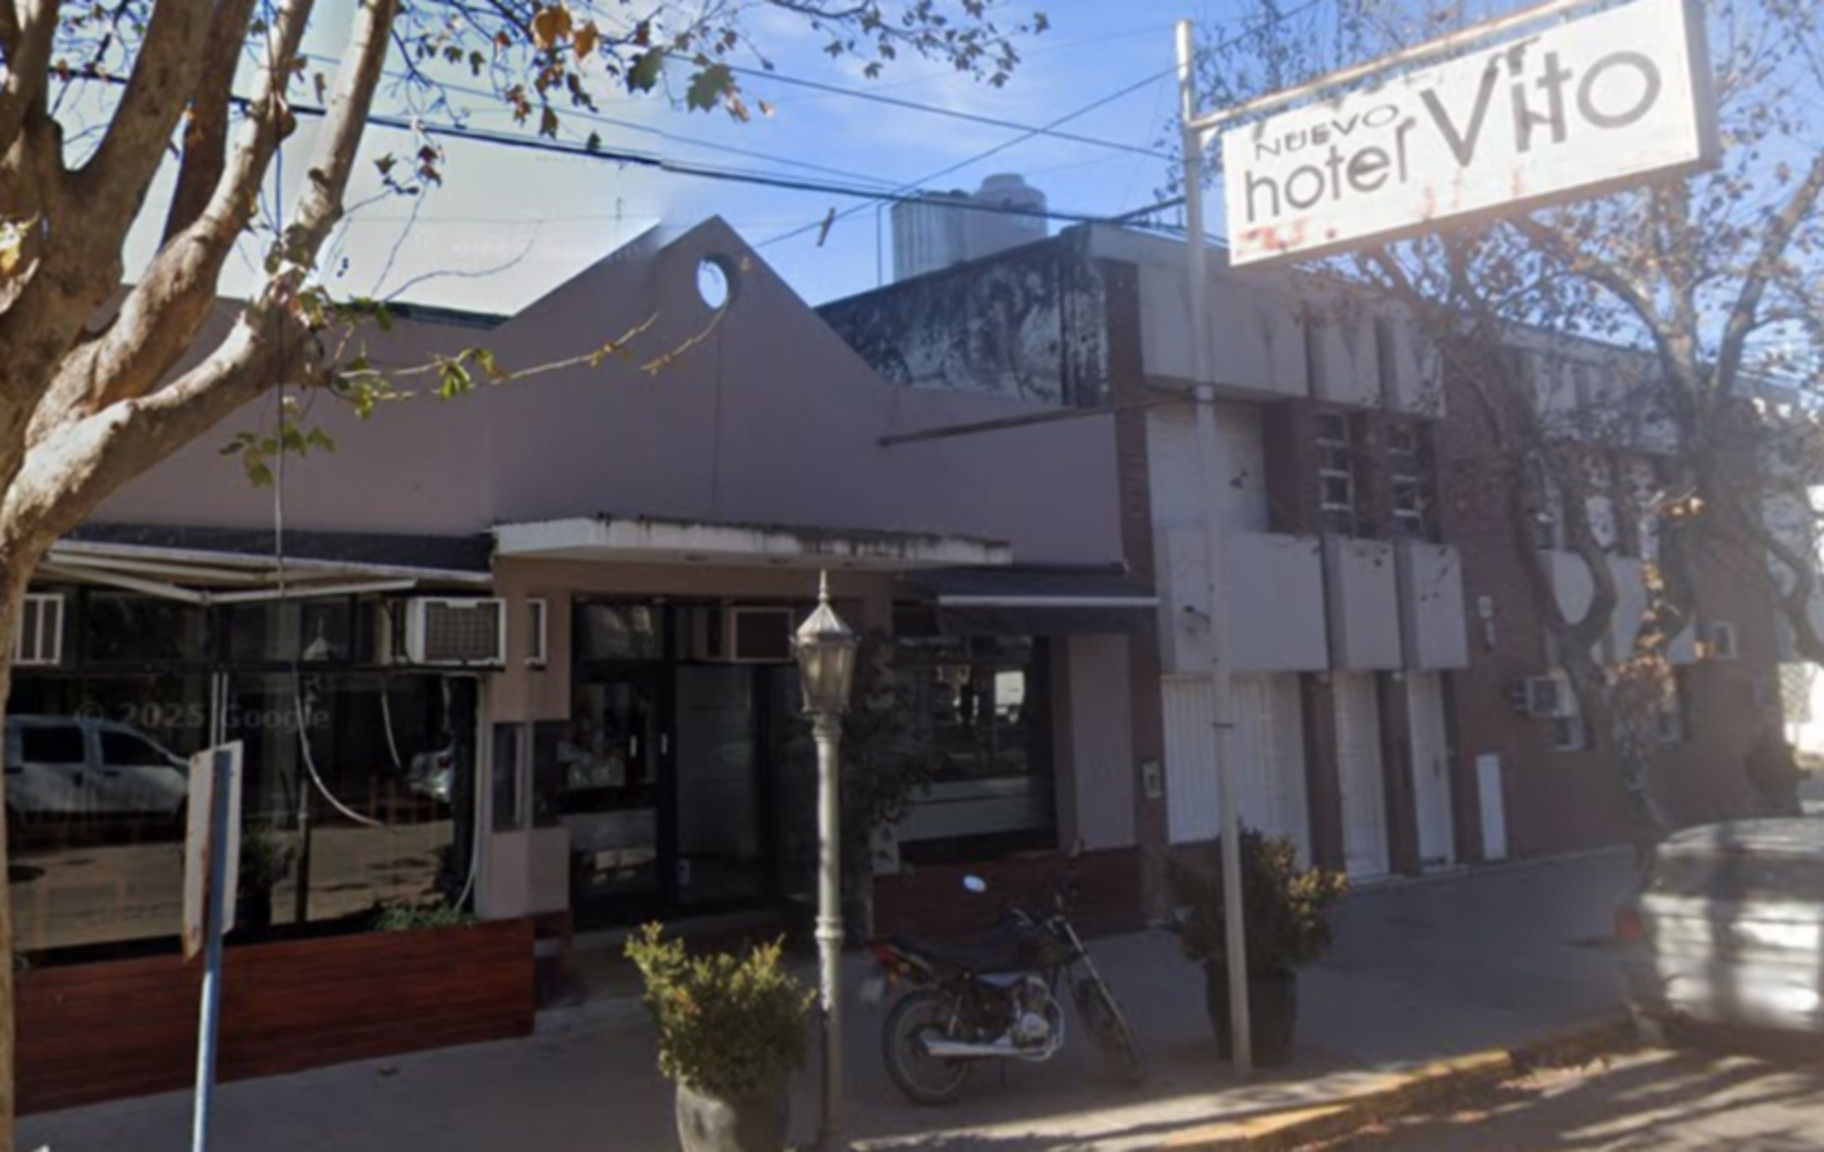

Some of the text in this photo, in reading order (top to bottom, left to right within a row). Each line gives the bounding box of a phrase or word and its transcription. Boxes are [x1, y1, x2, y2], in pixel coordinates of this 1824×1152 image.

[1245, 46, 1662, 222] hotel Vito
[1255, 105, 1399, 160] NUEVO
